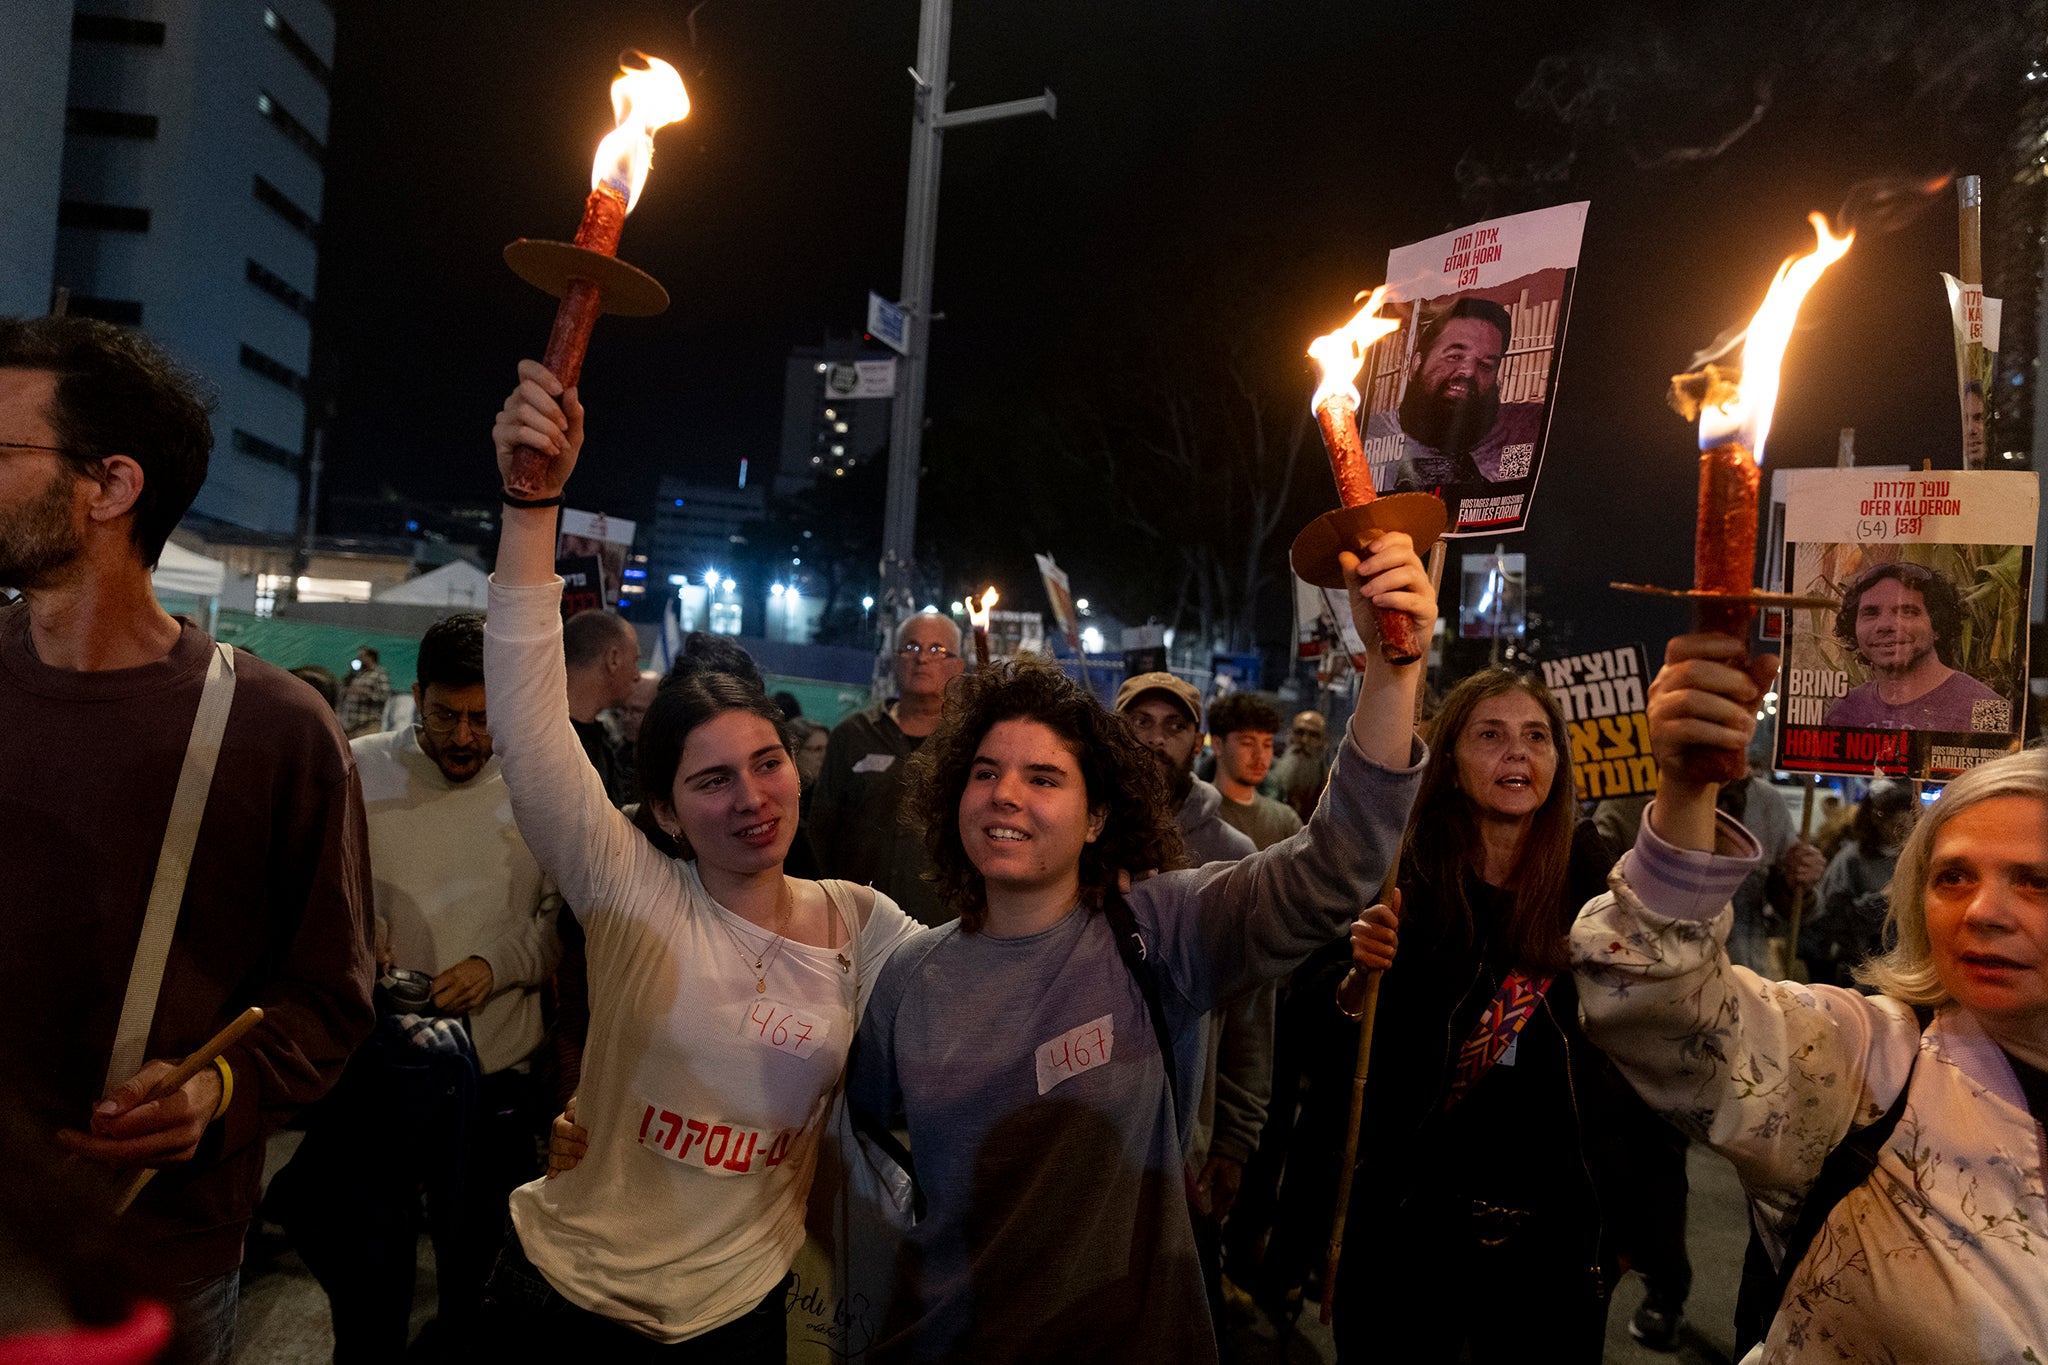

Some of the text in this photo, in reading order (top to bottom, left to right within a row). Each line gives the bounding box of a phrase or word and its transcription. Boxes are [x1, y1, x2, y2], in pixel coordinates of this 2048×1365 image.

[1452, 227, 1499, 255] איתן הורן
[1443, 244, 1502, 273] EITAN HORN
[1458, 266, 1478, 288] (37)
[1364, 433, 1405, 464] BRING
[1460, 494, 1525, 508] HOSTAGES AND MISSING
[1873, 480, 1950, 499] עופר קלדרון
[1458, 504, 1522, 522] FAMILIES FORUM
[1860, 499, 1961, 516] OFER KALDERON
[1856, 519, 1887, 540] (54)
[1541, 647, 1639, 688] תוציאו
[1788, 668, 1848, 698] BRING
[1787, 697, 1823, 726] HIM
[1785, 729, 1908, 763] HOME NOW!
[1931, 745, 1965, 757] HOSTAGES
[1965, 747, 1980, 758] AND
[1931, 755, 1973, 770] FAMILIES
[751, 1003, 813, 1050] 467
[1050, 1027, 1106, 1072] 467
